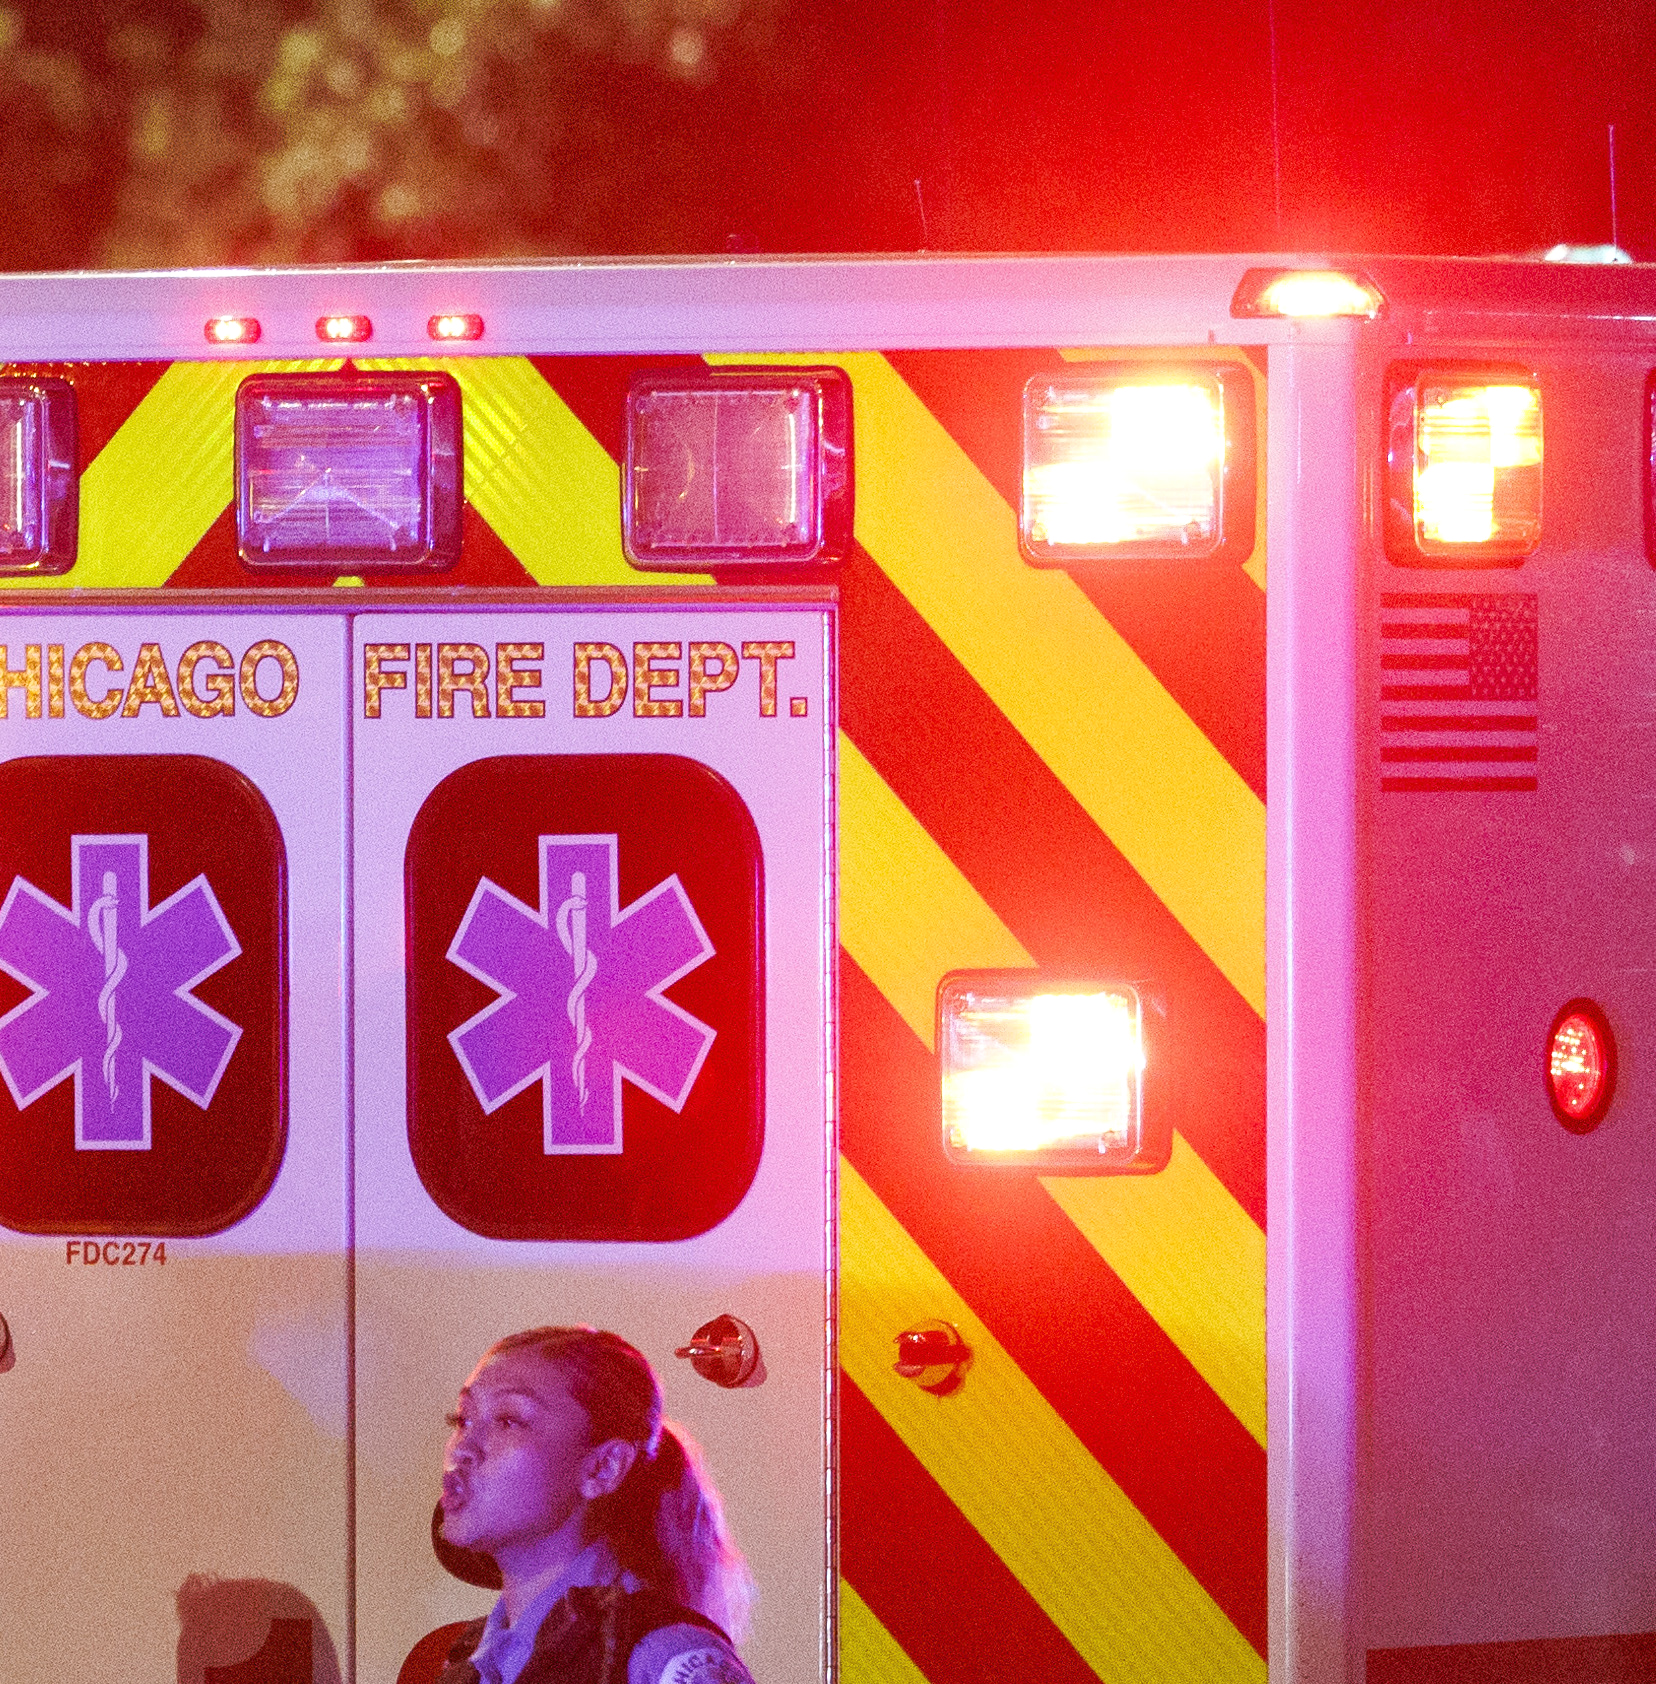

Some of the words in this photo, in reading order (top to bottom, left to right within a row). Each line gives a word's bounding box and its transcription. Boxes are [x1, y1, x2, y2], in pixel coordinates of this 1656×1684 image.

[362, 641, 547, 720] FIRE
[572, 641, 810, 720] DEPT.
[66, 1240, 167, 1266] FDC274
